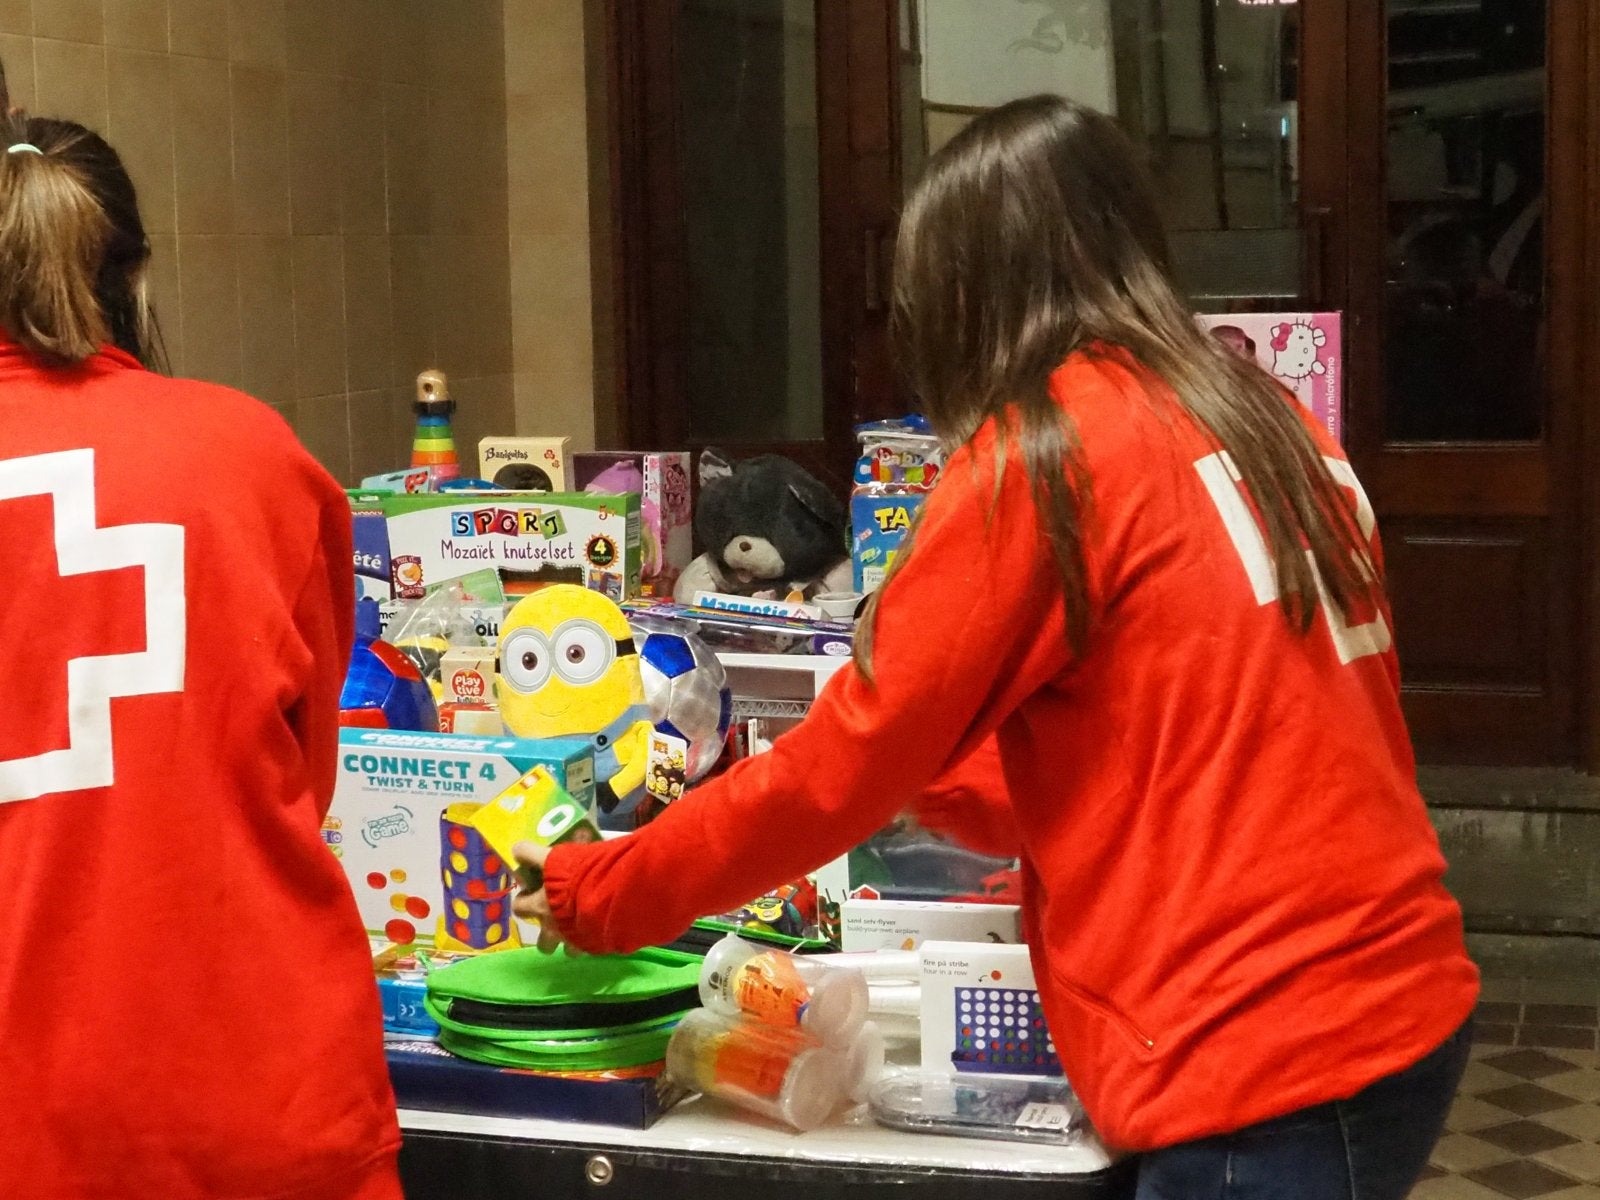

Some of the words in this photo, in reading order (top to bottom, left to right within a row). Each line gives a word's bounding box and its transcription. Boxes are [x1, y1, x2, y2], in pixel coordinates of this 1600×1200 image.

[1326, 357, 1335, 404] micrófono
[455, 510, 559, 537] SPORT
[441, 540, 496, 559] Mozaïek
[503, 540, 576, 559] knutselset
[594, 539, 607, 554] 4
[455, 676, 481, 689] Play
[456, 684, 481, 695] tive
[343, 754, 471, 779] CONNECT
[479, 762, 496, 781] 4
[367, 776, 413, 788] TWIST
[417, 779, 428, 790] &
[433, 780, 474, 793] TURN
